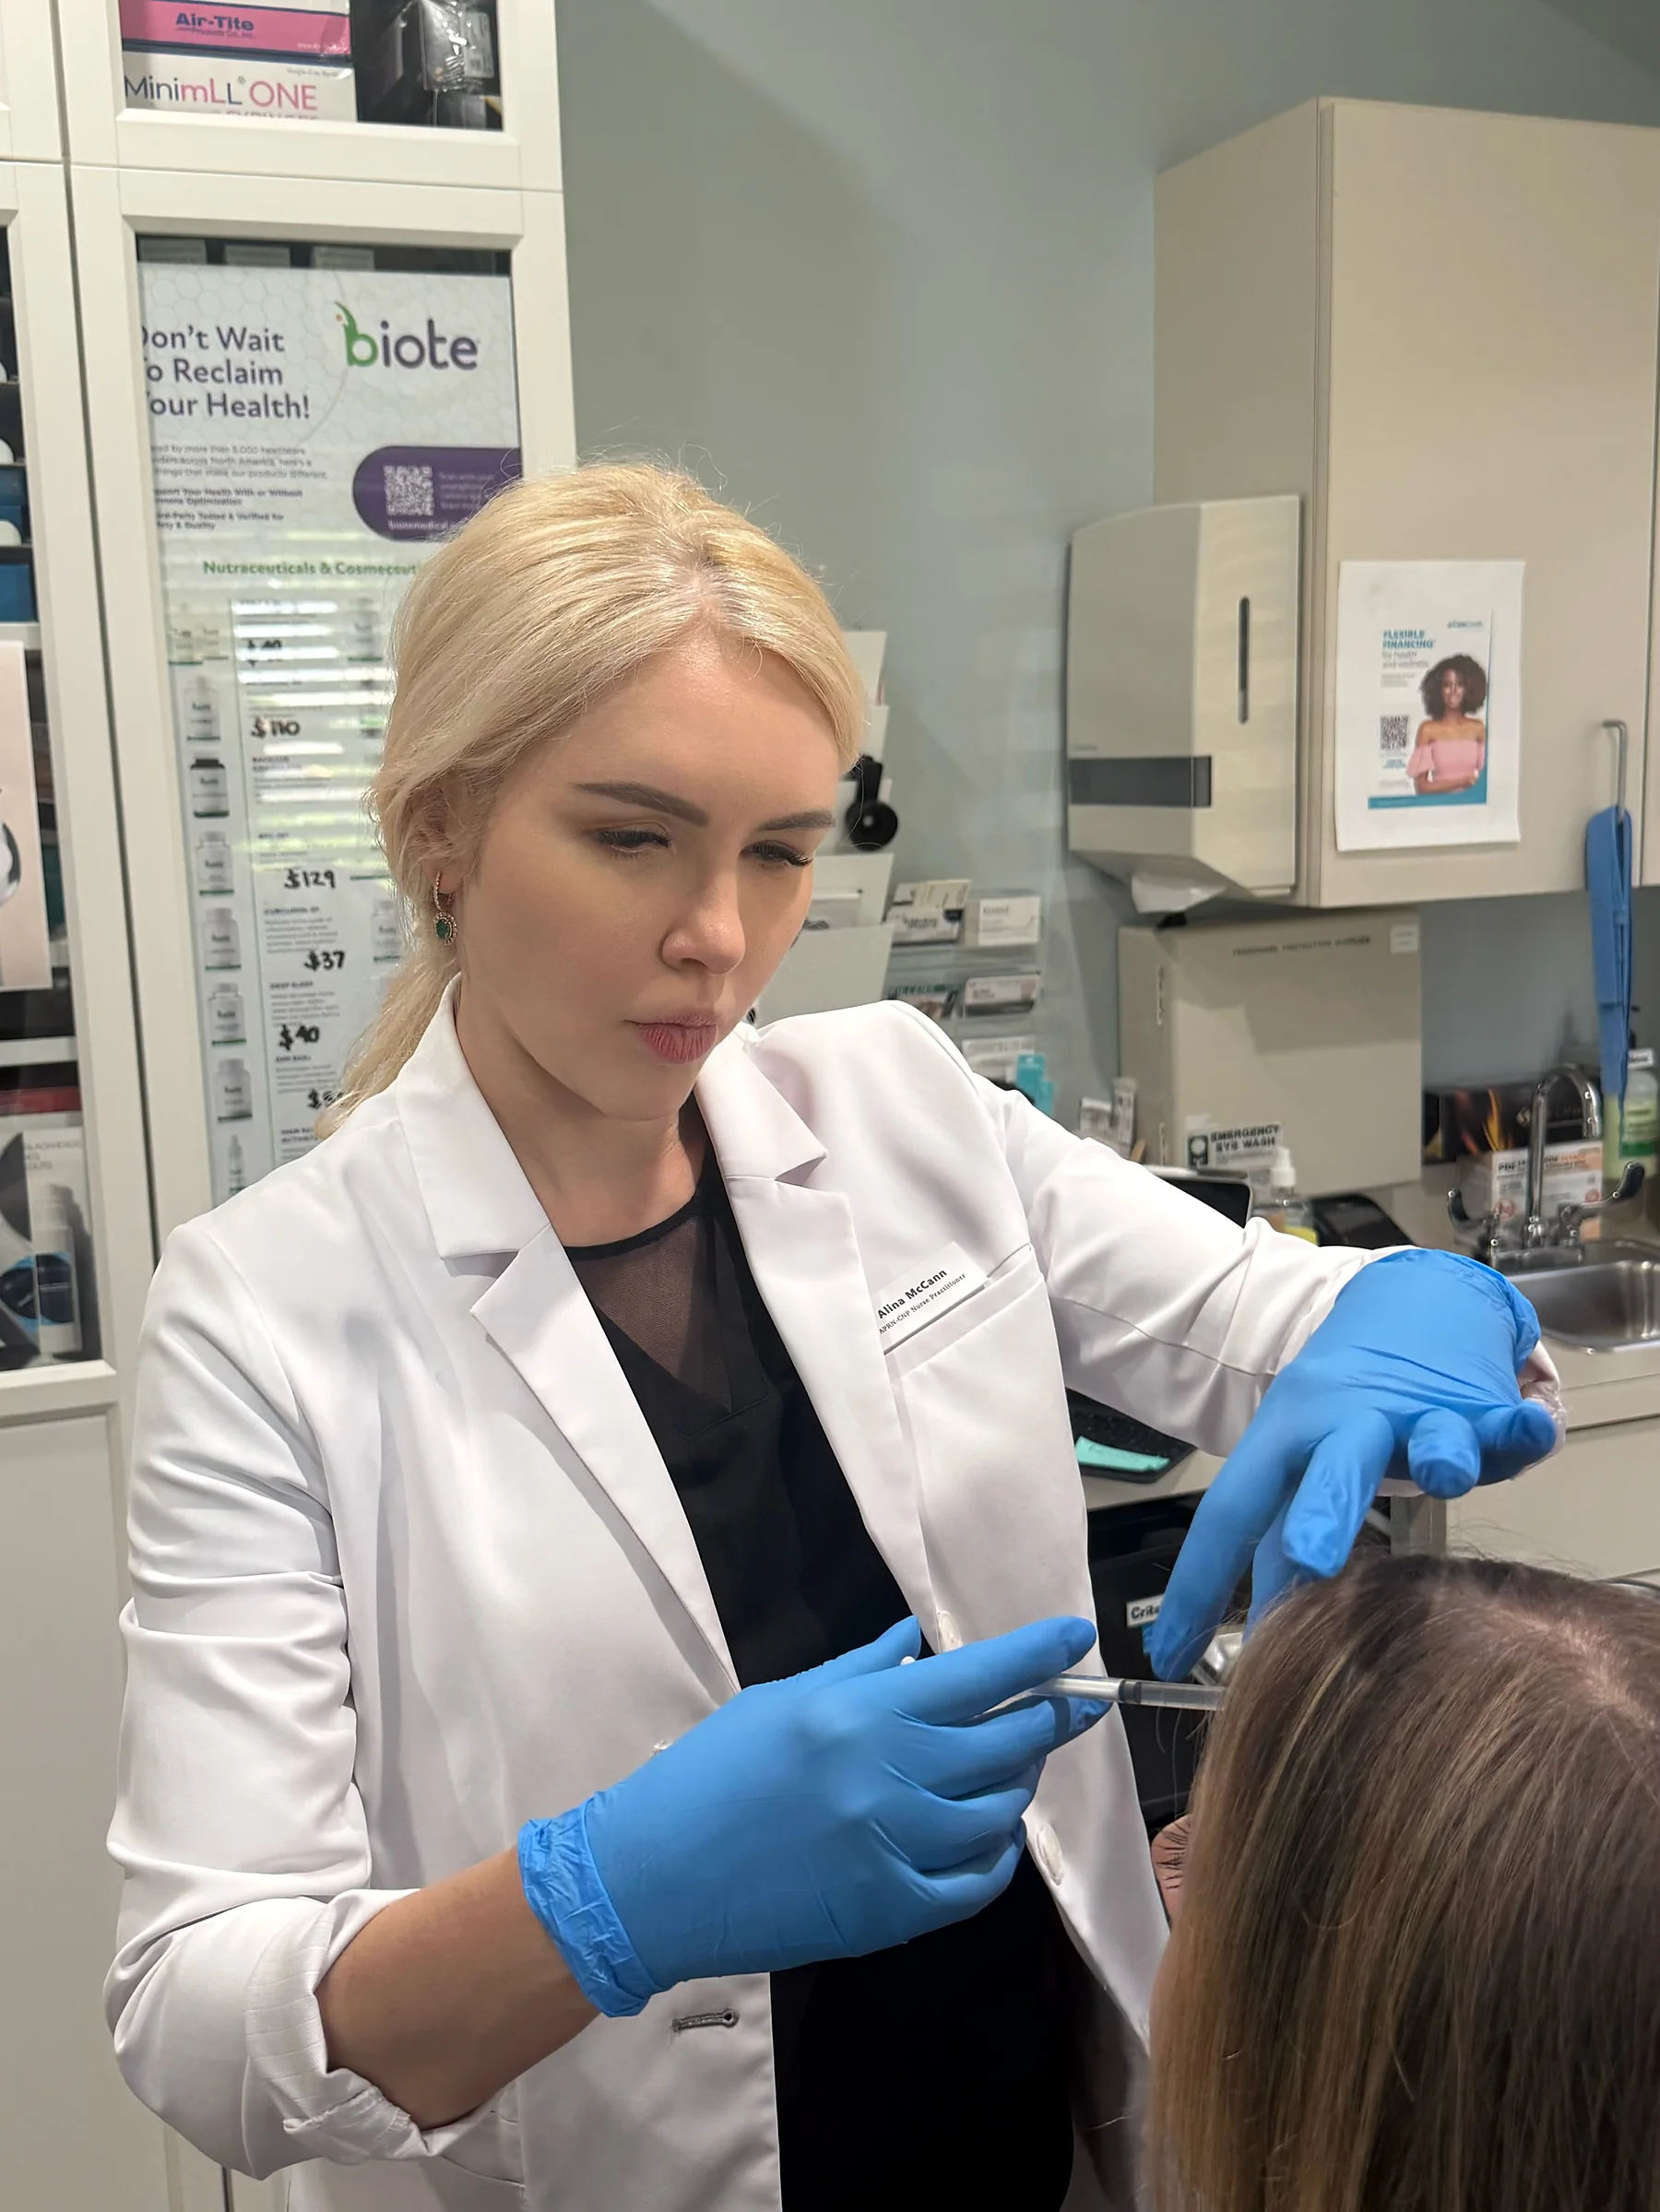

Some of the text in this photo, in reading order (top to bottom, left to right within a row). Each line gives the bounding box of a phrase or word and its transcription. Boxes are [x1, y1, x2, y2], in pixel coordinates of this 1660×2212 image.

[175, 12, 255, 31] Air-Tite
[249, 80, 318, 111] ONE
[217, 326, 285, 352] Wait
[334, 302, 478, 371] biote
[144, 358, 283, 385] o Reclaim
[147, 391, 311, 420] our Health!
[203, 561, 316, 575] Nutraceuticals
[336, 562, 418, 574] Cosmeceut
[284, 869, 337, 890] $129
[304, 950, 346, 971] $37
[1210, 1124, 1280, 1142] EMERGENCY
[1242, 1136, 1275, 1149] WASH
[877, 1270, 948, 1319] Alina McCann
[879, 1310, 911, 1335] APRN-CNP
[910, 1298, 931, 1313] Nurse
